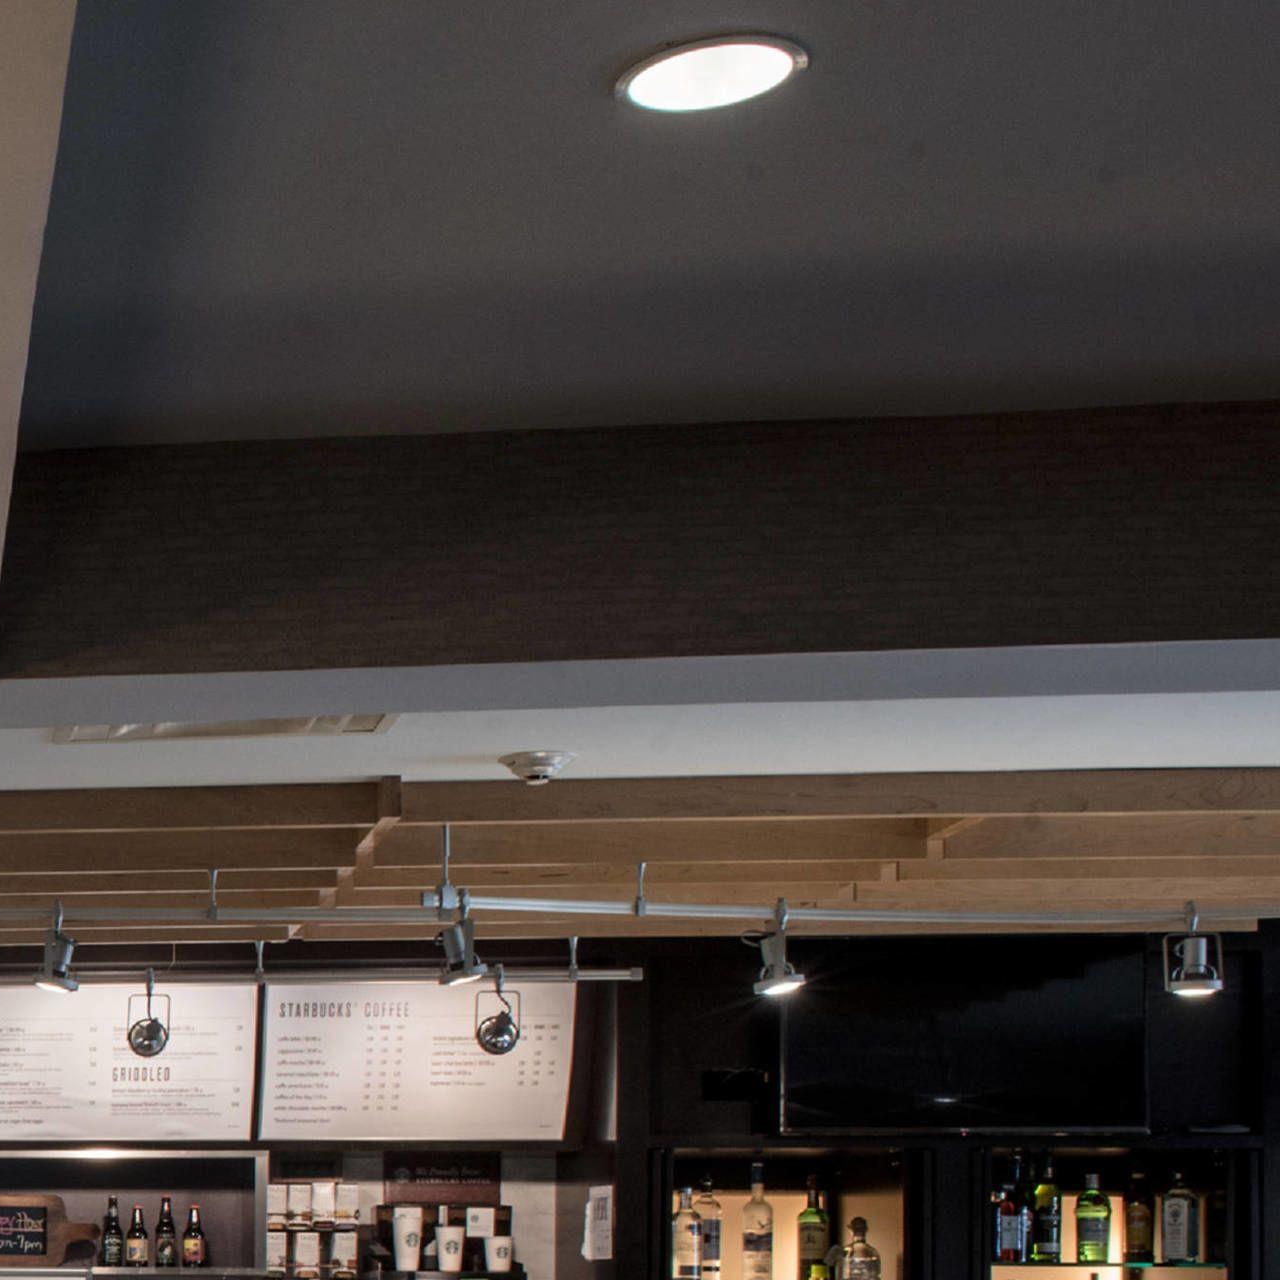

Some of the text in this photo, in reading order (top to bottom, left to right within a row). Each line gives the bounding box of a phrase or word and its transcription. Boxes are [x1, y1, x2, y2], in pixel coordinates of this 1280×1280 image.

[279, 1001, 409, 1018] STARBUCKS COFFEE
[111, 1066, 171, 1083] GRIDDLED
